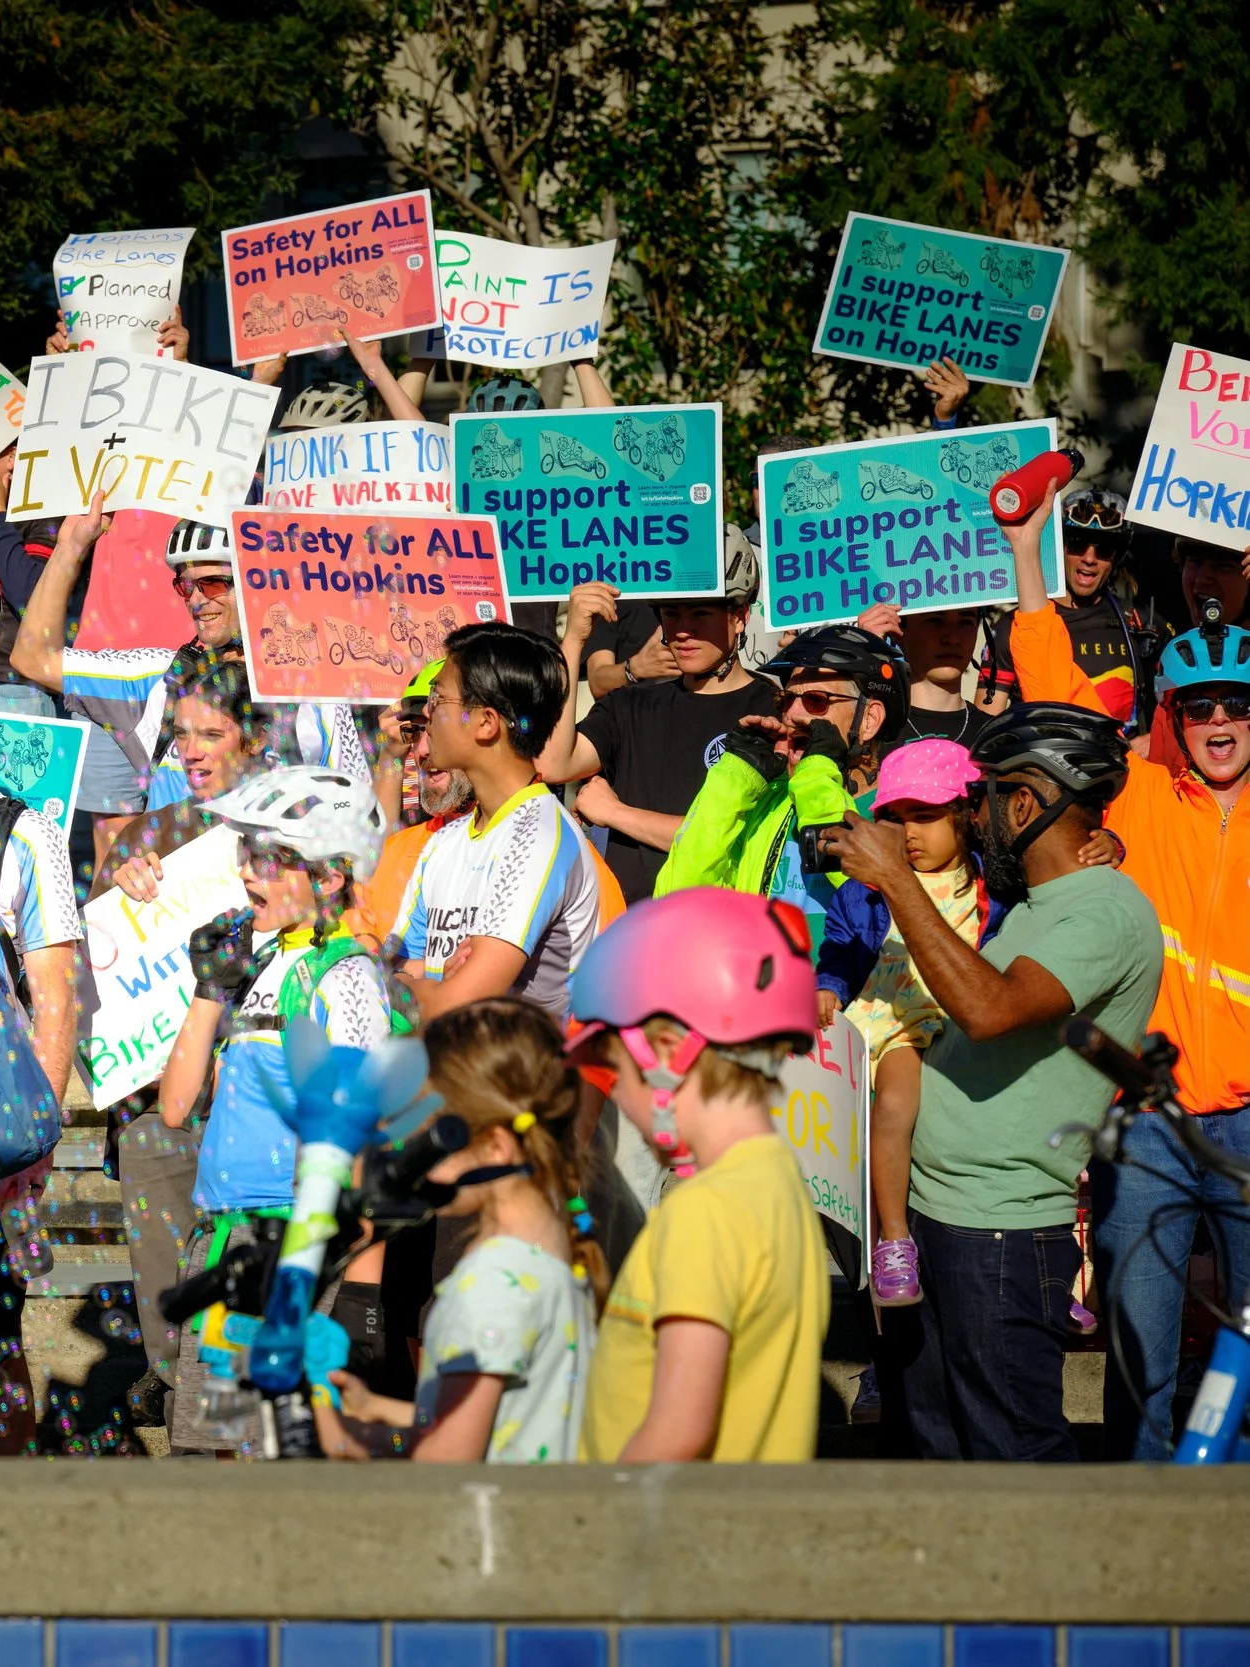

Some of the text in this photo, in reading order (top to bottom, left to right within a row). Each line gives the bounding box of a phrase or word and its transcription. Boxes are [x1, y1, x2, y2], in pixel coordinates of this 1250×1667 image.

[70, 232, 184, 246] Hopkins
[232, 204, 425, 260] Safety for ALL
[59, 247, 176, 265] Bike Lanes
[234, 269, 267, 287] on
[275, 243, 384, 277] Hopkins
[435, 239, 527, 300] PAINT
[539, 270, 593, 306] IS
[88, 274, 171, 301] Planned
[842, 265, 853, 288] I
[860, 274, 984, 312] support
[80, 311, 171, 333] Approve
[426, 320, 599, 360] PROTECTION
[834, 293, 910, 328] BIKE
[917, 309, 1023, 347] LANES
[827, 326, 999, 370] on Hopkins
[24, 356, 270, 462] I BIKE
[11, 444, 214, 514] I VOTE!
[268, 434, 348, 486] HONK
[359, 431, 399, 474] IF
[264, 479, 450, 509] LOVE WALKIN
[462, 479, 631, 519] I support
[1135, 443, 1250, 531] HOPKI
[241, 520, 494, 562] Safety for ALL
[501, 513, 690, 551] KE LANES
[773, 517, 783, 548] I
[799, 498, 962, 544] support
[520, 550, 673, 589] Hopkins
[776, 543, 870, 583] BIKE
[887, 527, 1015, 568] LANES
[246, 560, 446, 597] on Hopkins
[776, 564, 1010, 617] on Hopkins
[867, 680, 893, 693] SMITH
[78, 1010, 177, 1088] BIKE
[770, 1088, 839, 1158] OR
[366, 1306, 378, 1336] FOX
